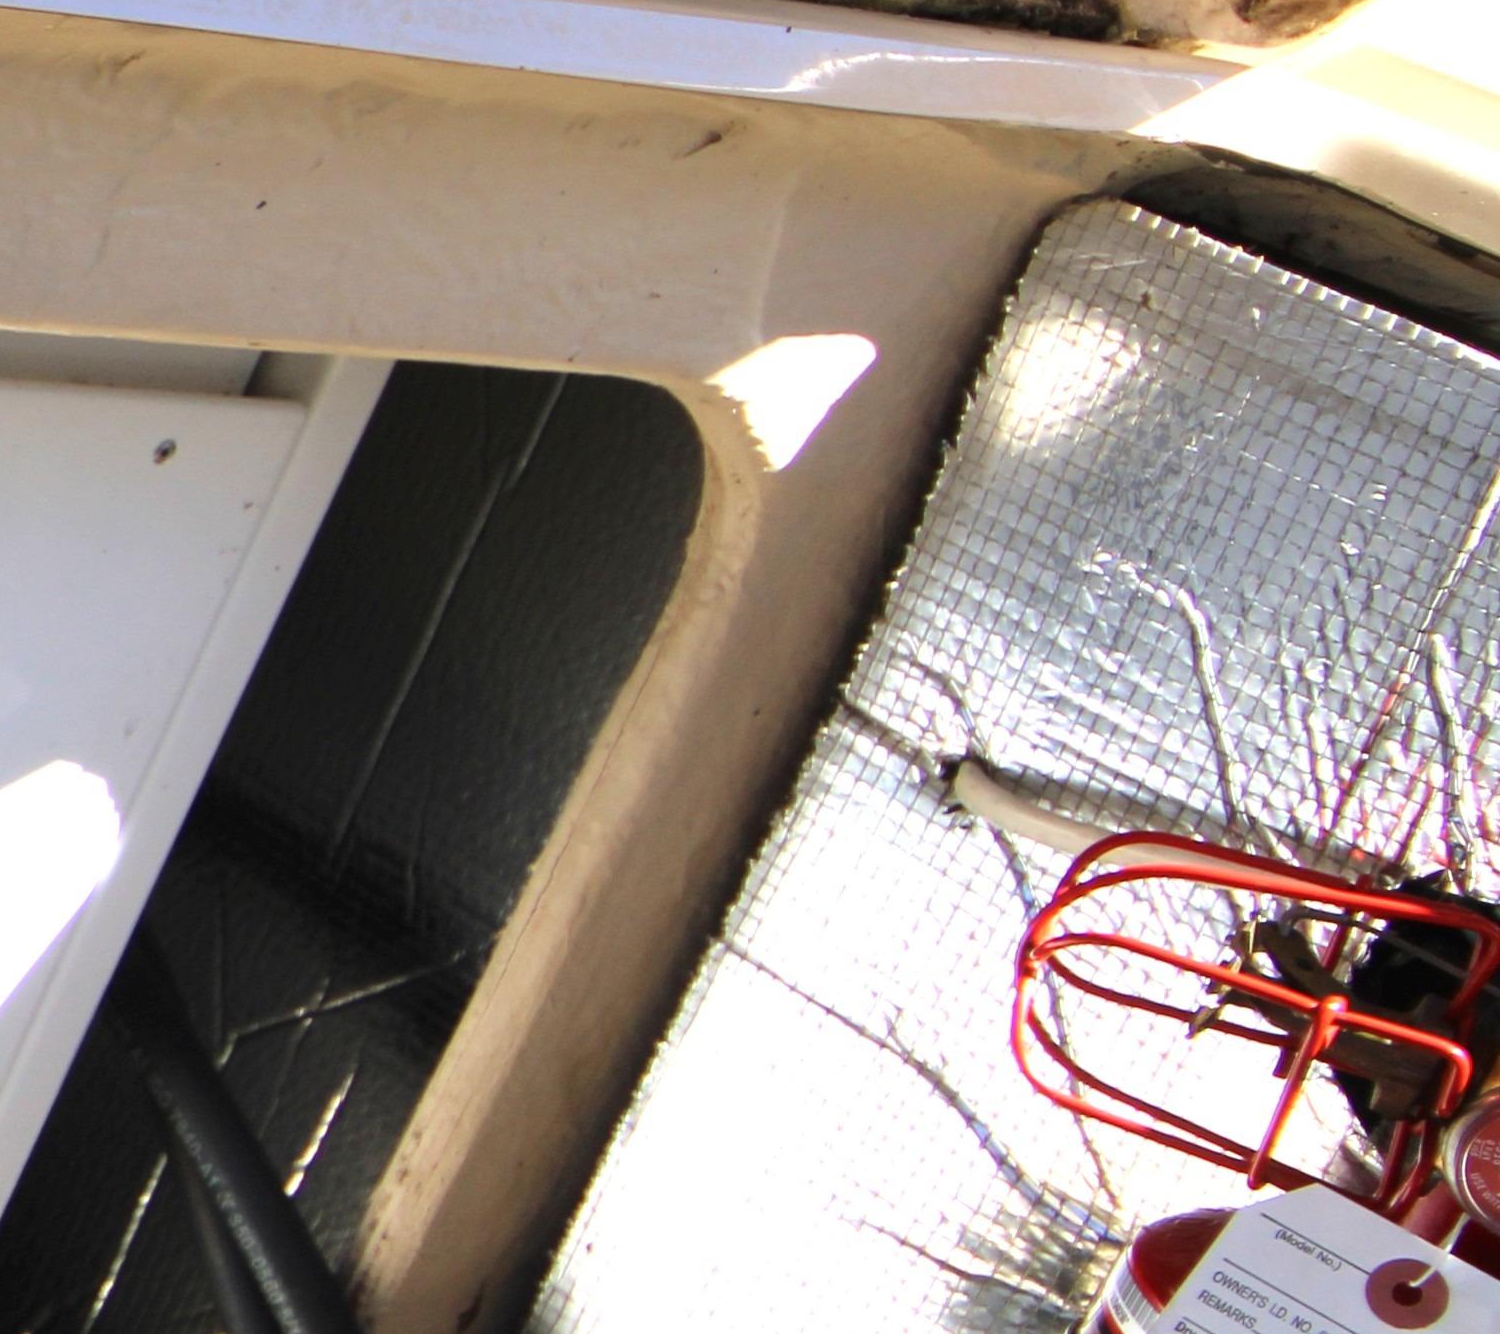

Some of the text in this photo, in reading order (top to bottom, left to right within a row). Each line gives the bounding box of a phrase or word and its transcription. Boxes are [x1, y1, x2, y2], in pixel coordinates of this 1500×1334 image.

[1274, 1229, 1341, 1271] (Model No.)
[1197, 1289, 1256, 1332] REMARKS
[1212, 1270, 1269, 1308] OWNER'S
[1290, 1315, 1312, 1333] NO.
